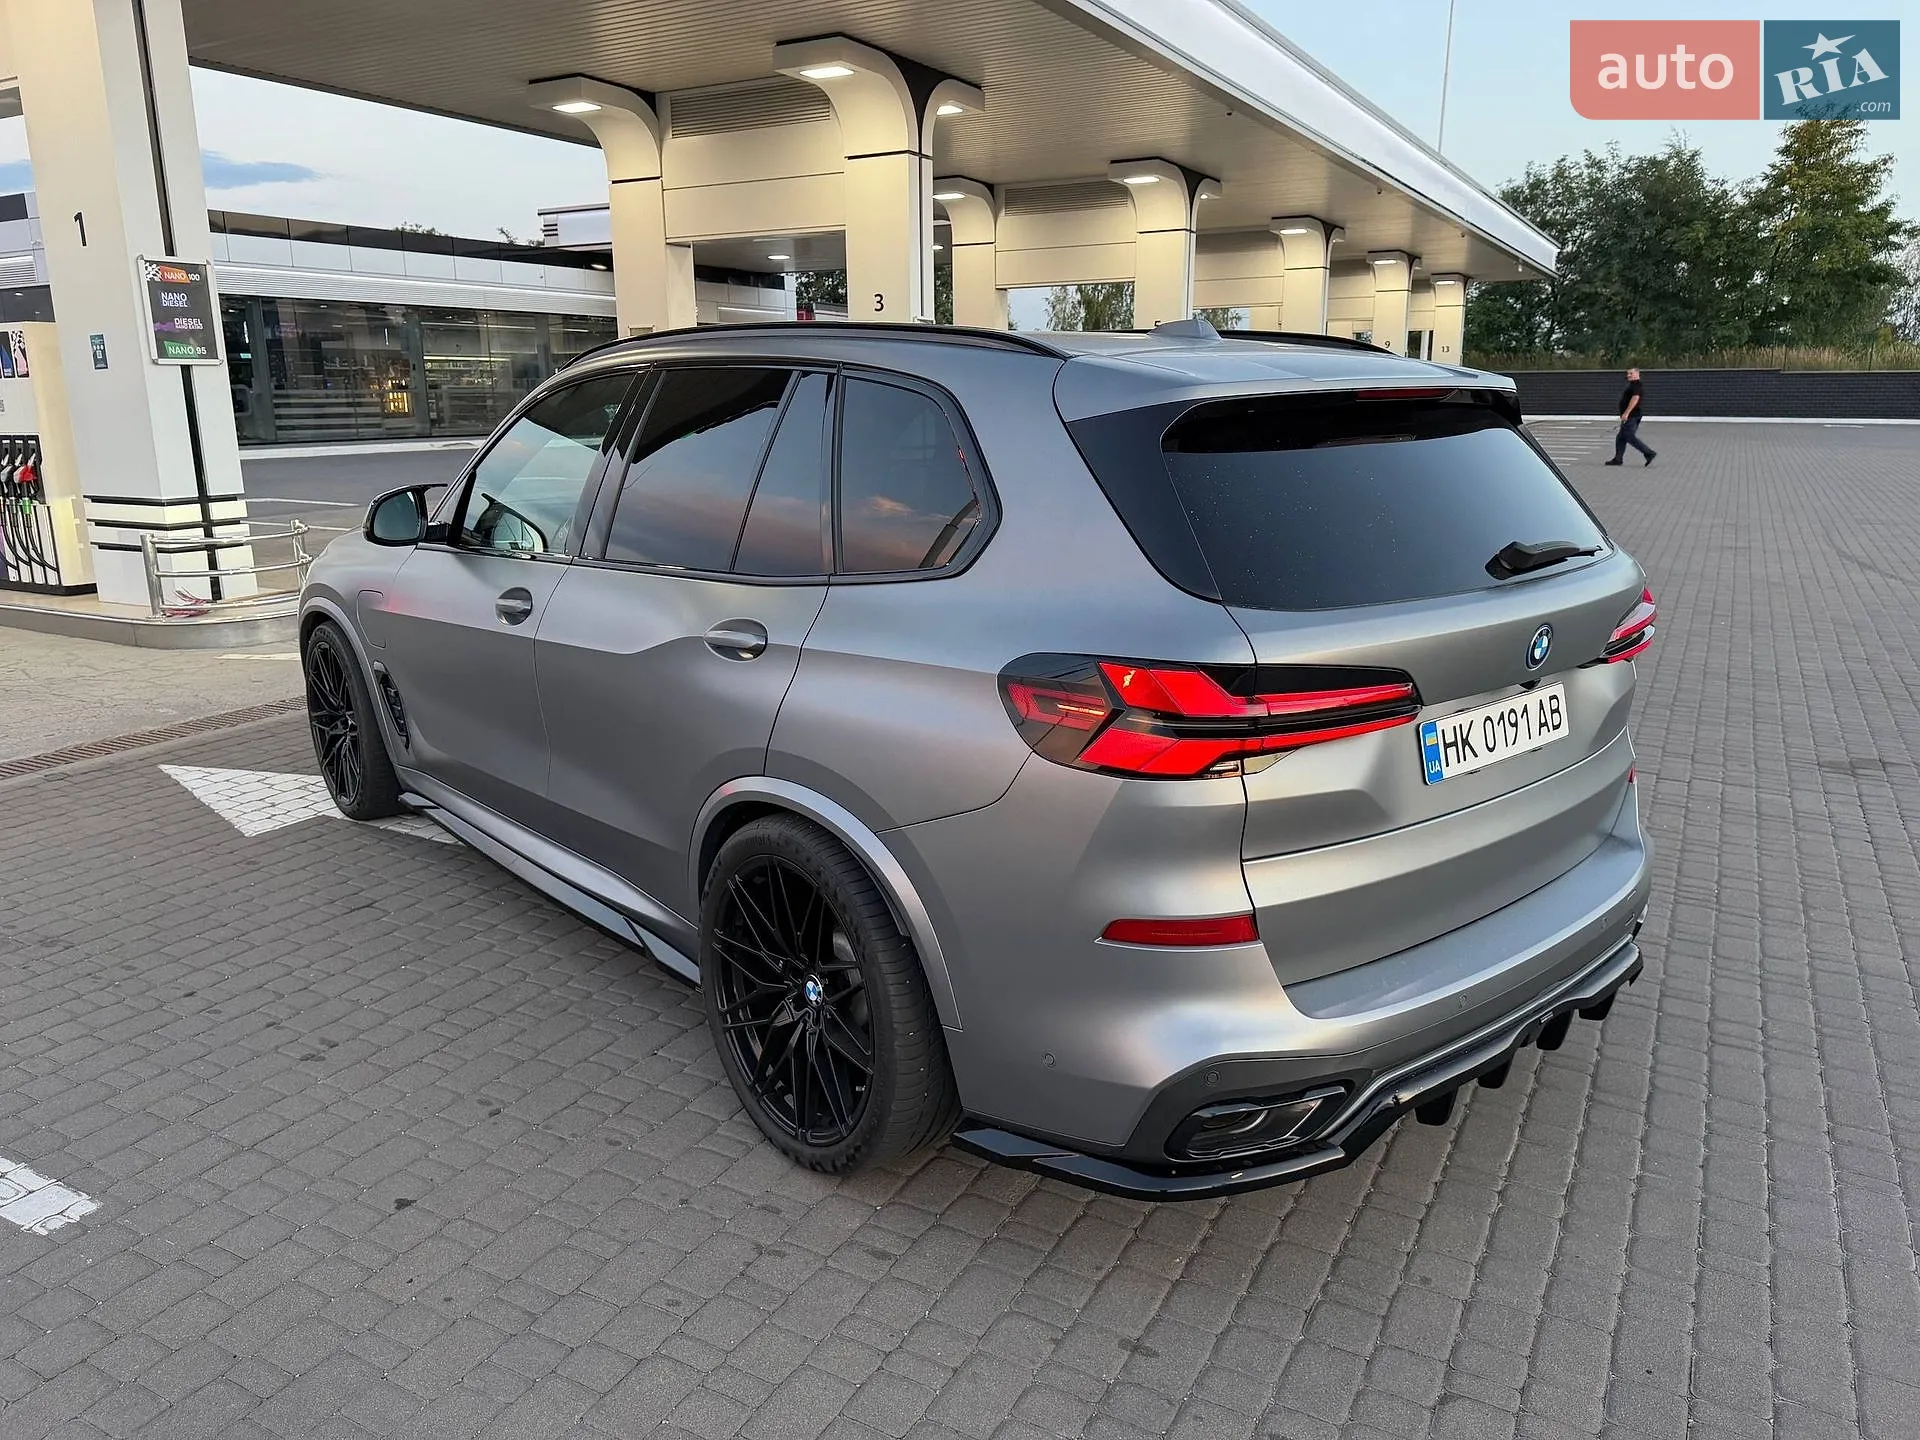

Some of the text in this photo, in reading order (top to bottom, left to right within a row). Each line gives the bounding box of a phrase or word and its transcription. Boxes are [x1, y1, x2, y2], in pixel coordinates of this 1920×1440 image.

[73, 211, 87, 247] 1
[164, 272, 200, 281] NANO 100
[161, 292, 187, 301] NANO
[873, 293, 884, 312] 3
[174, 317, 203, 326] DIESEL
[1384, 340, 1391, 349] 9
[168, 346, 207, 355] NANO 95
[1441, 694, 1563, 768] HK 0191 AB
[1428, 761, 1441, 774] UA
